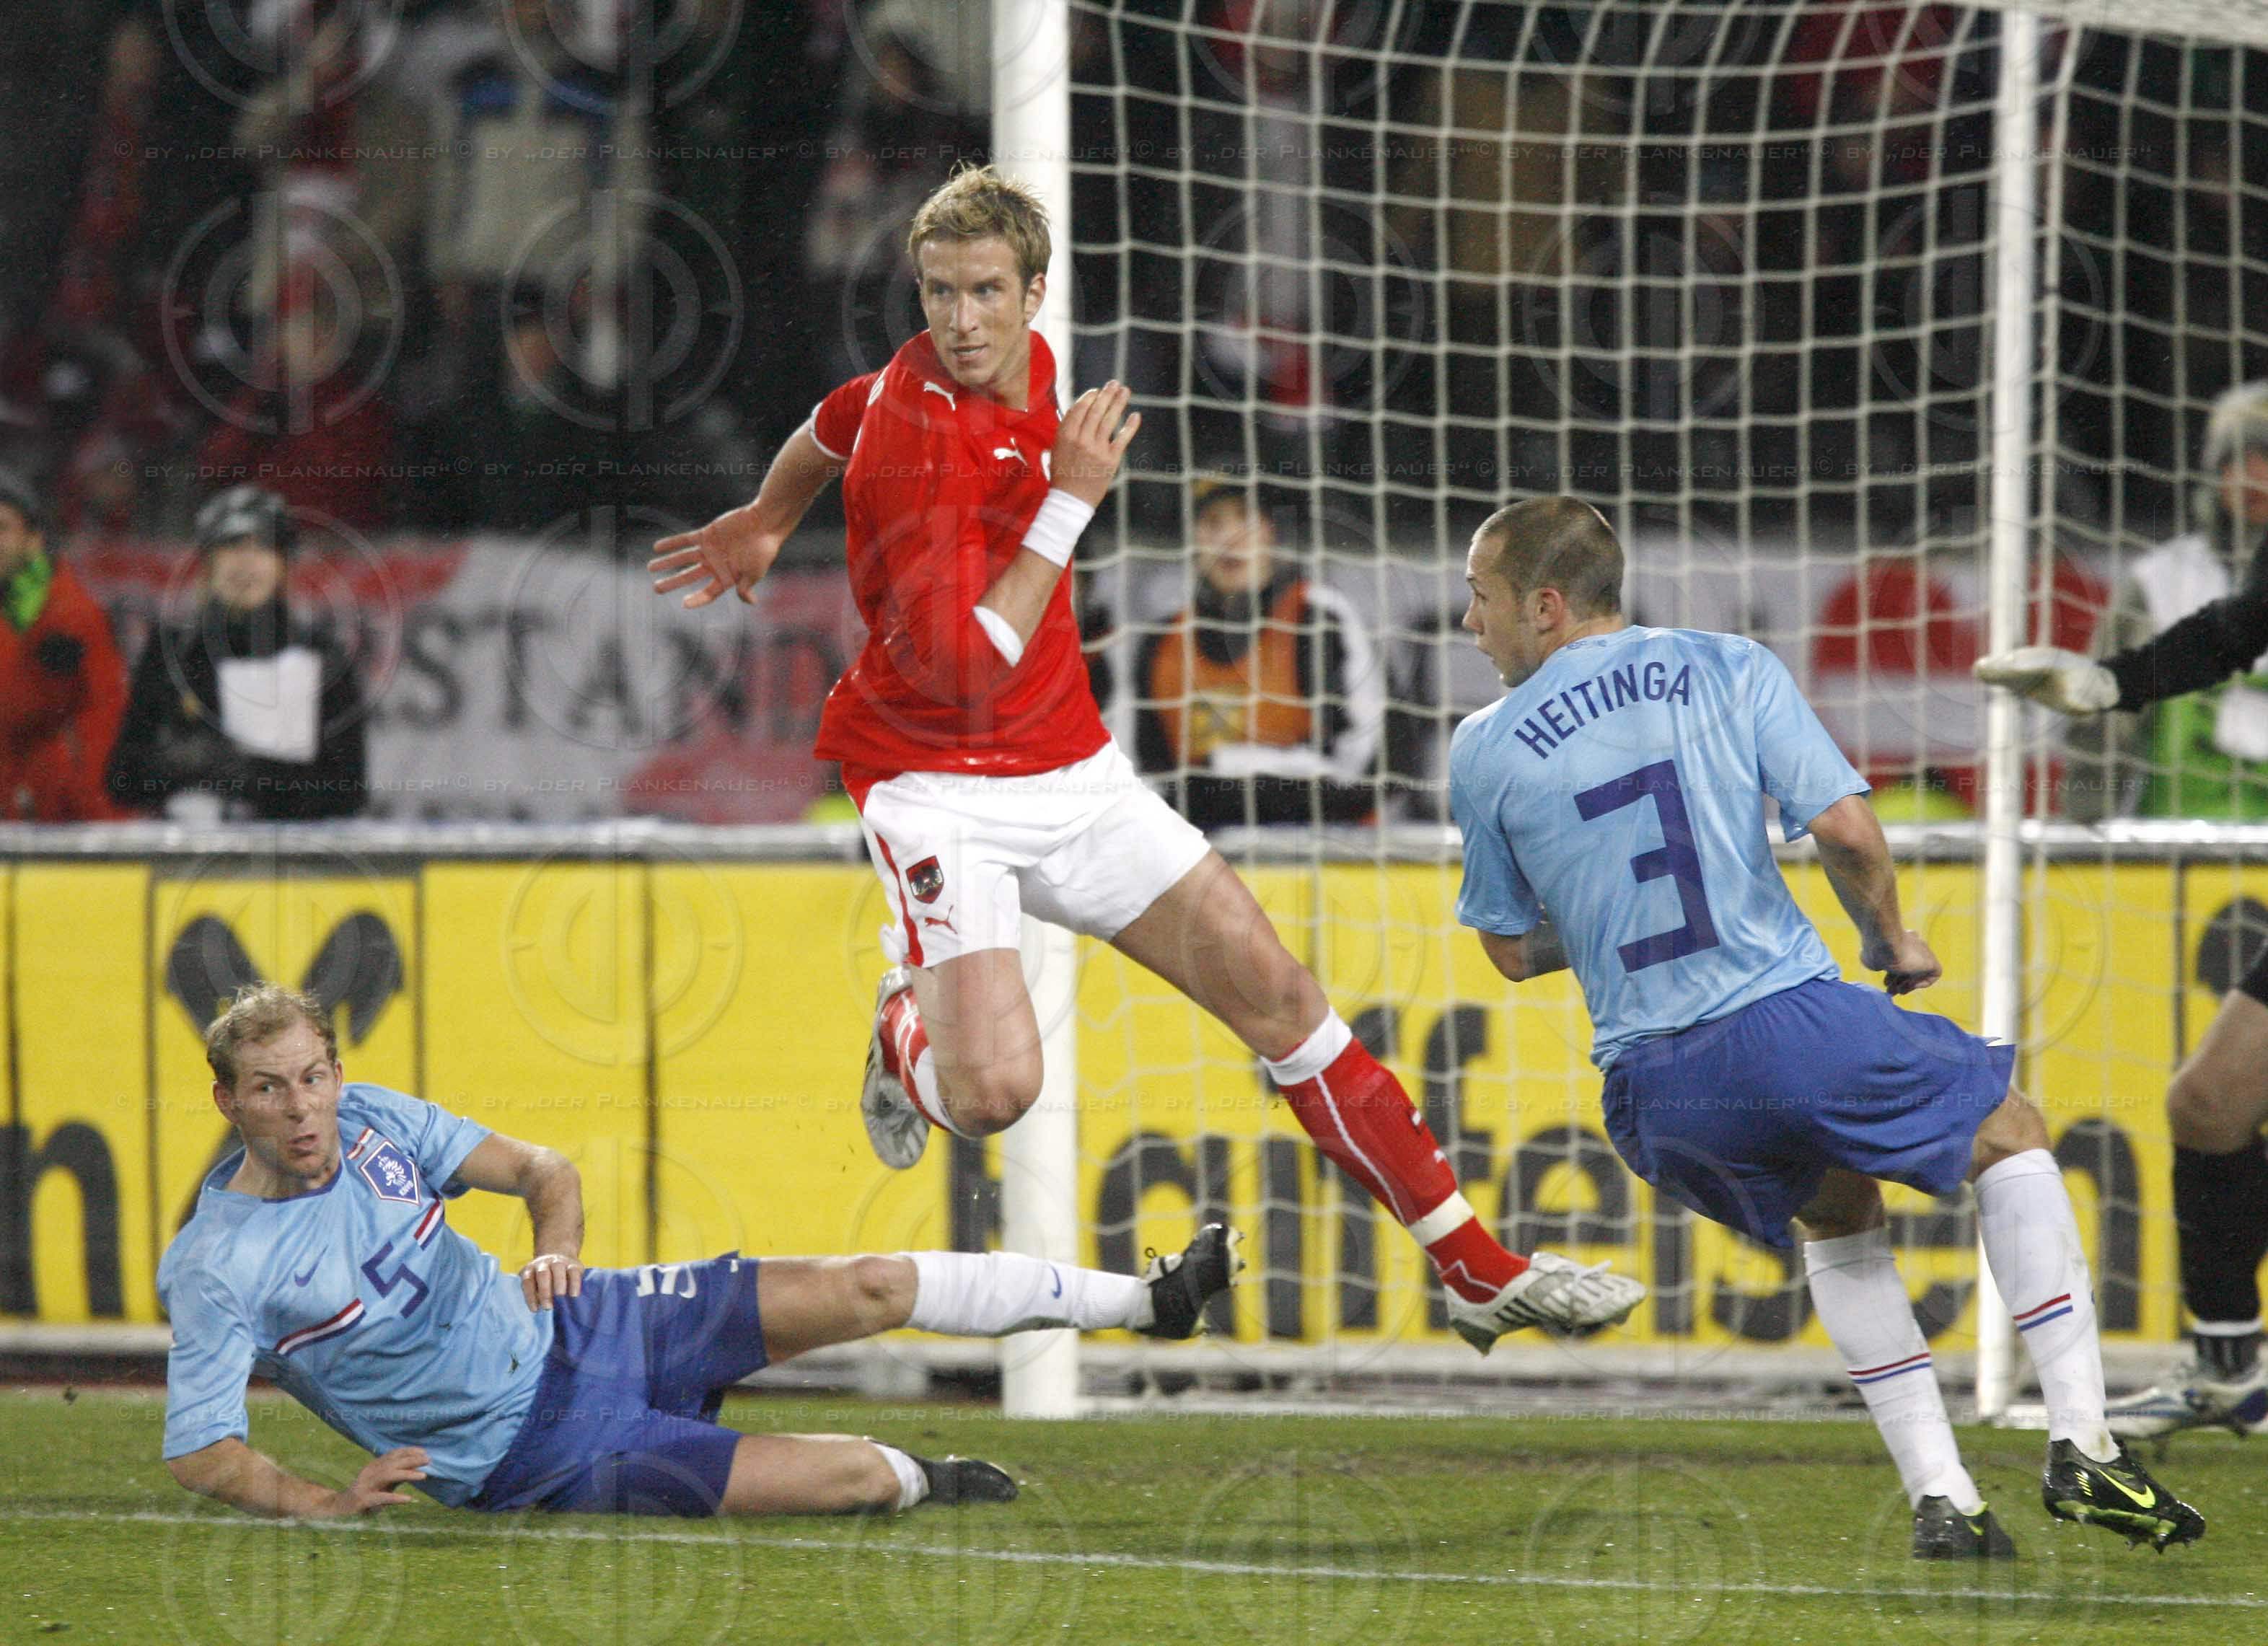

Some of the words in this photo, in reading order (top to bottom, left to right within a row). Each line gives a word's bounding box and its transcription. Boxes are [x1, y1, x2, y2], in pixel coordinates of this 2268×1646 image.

[1514, 661, 1690, 760] HEITINGA
[1573, 759, 1720, 974] 3
[360, 1239, 430, 1319] 5
